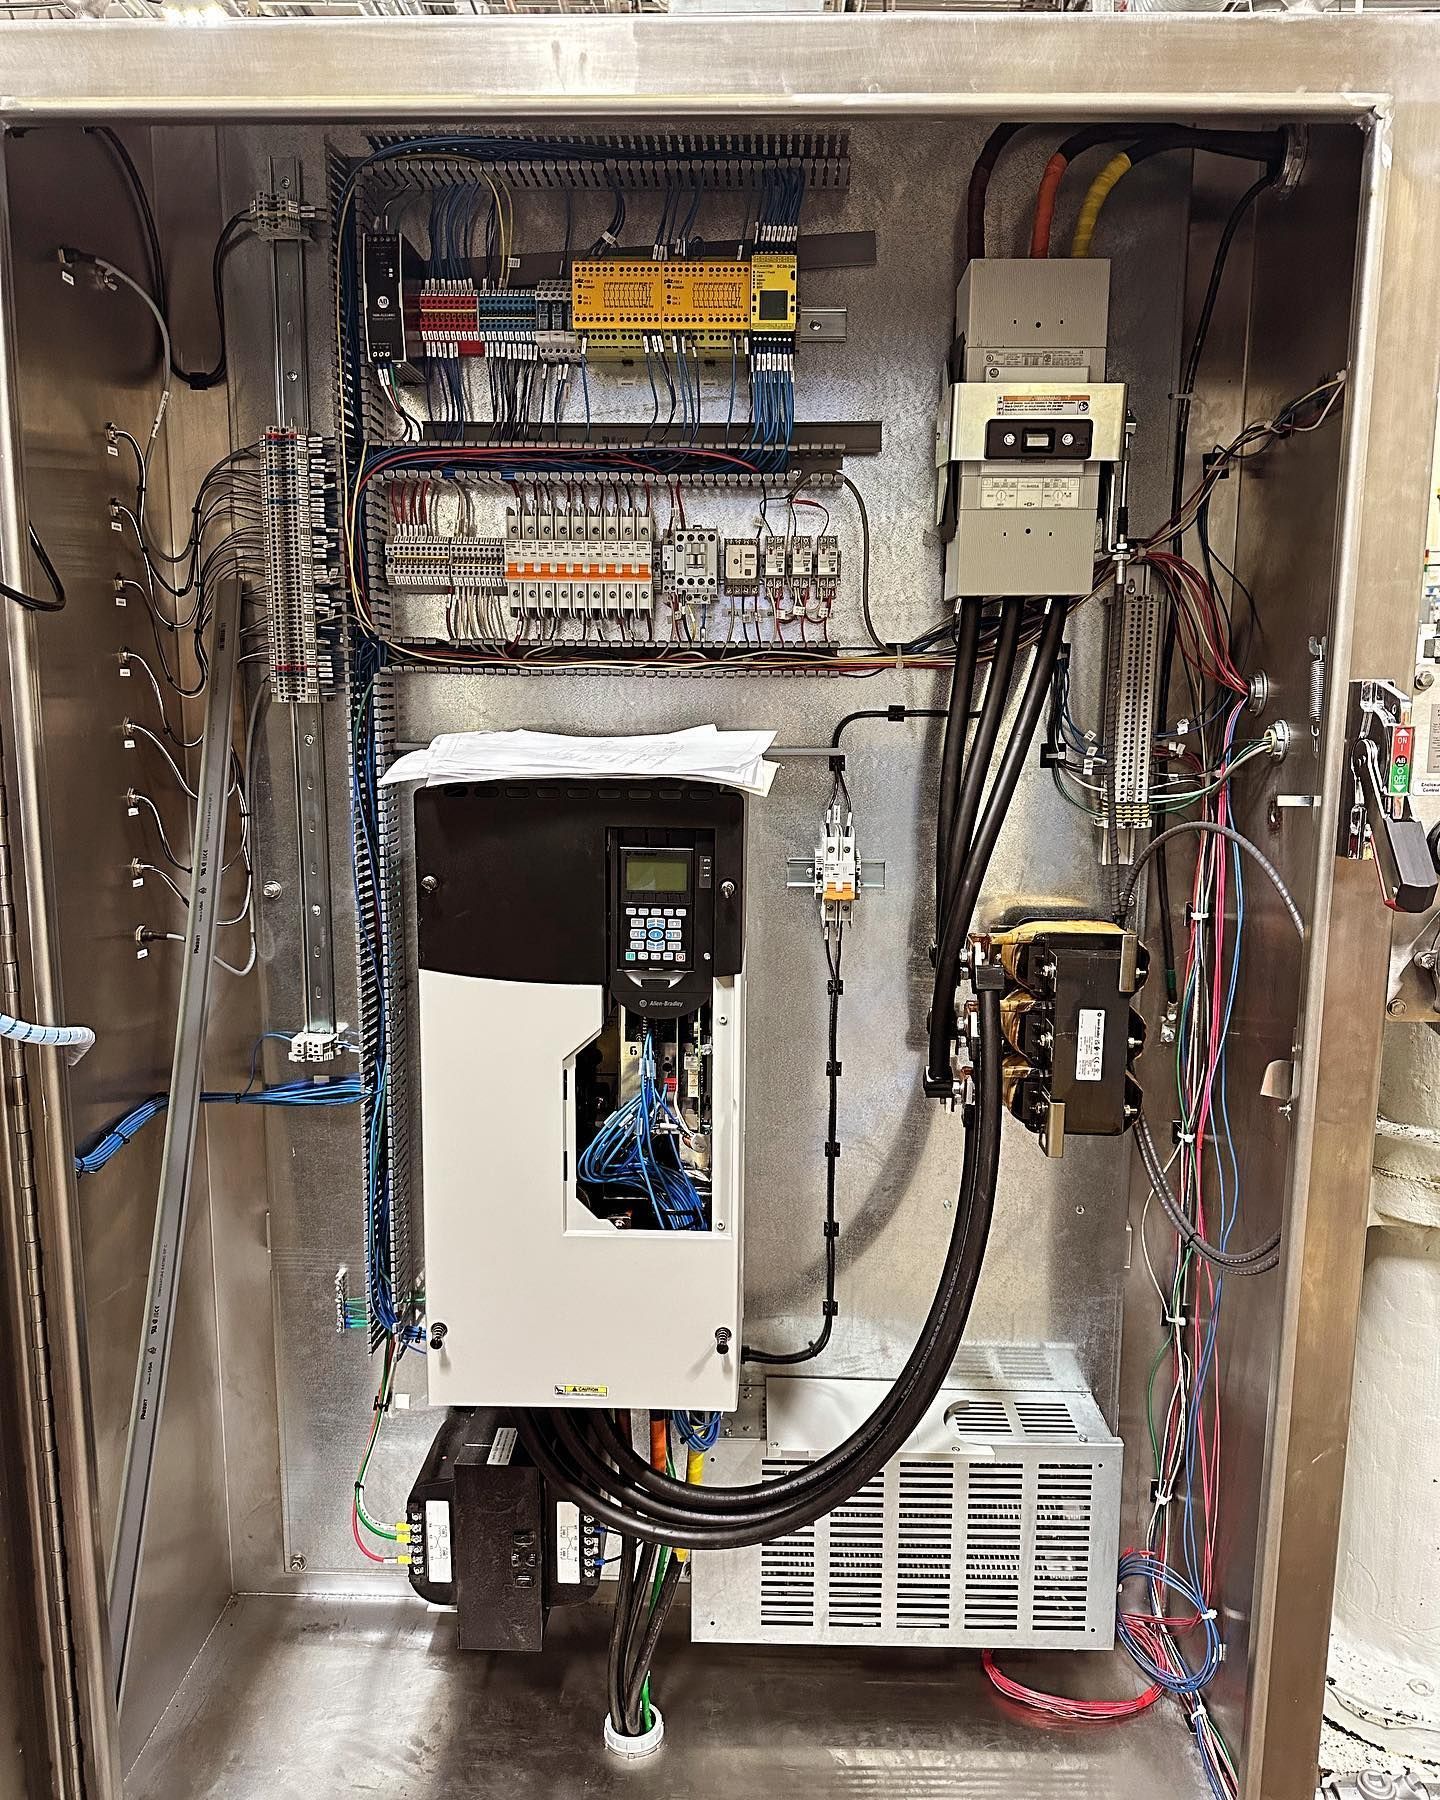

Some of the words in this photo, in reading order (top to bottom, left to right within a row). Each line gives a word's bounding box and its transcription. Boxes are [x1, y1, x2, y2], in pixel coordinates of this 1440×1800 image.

[1394, 775, 1406, 783] OFF
[649, 1000, 684, 1008] Allen-Bradley
[630, 1046, 638, 1056] 6
